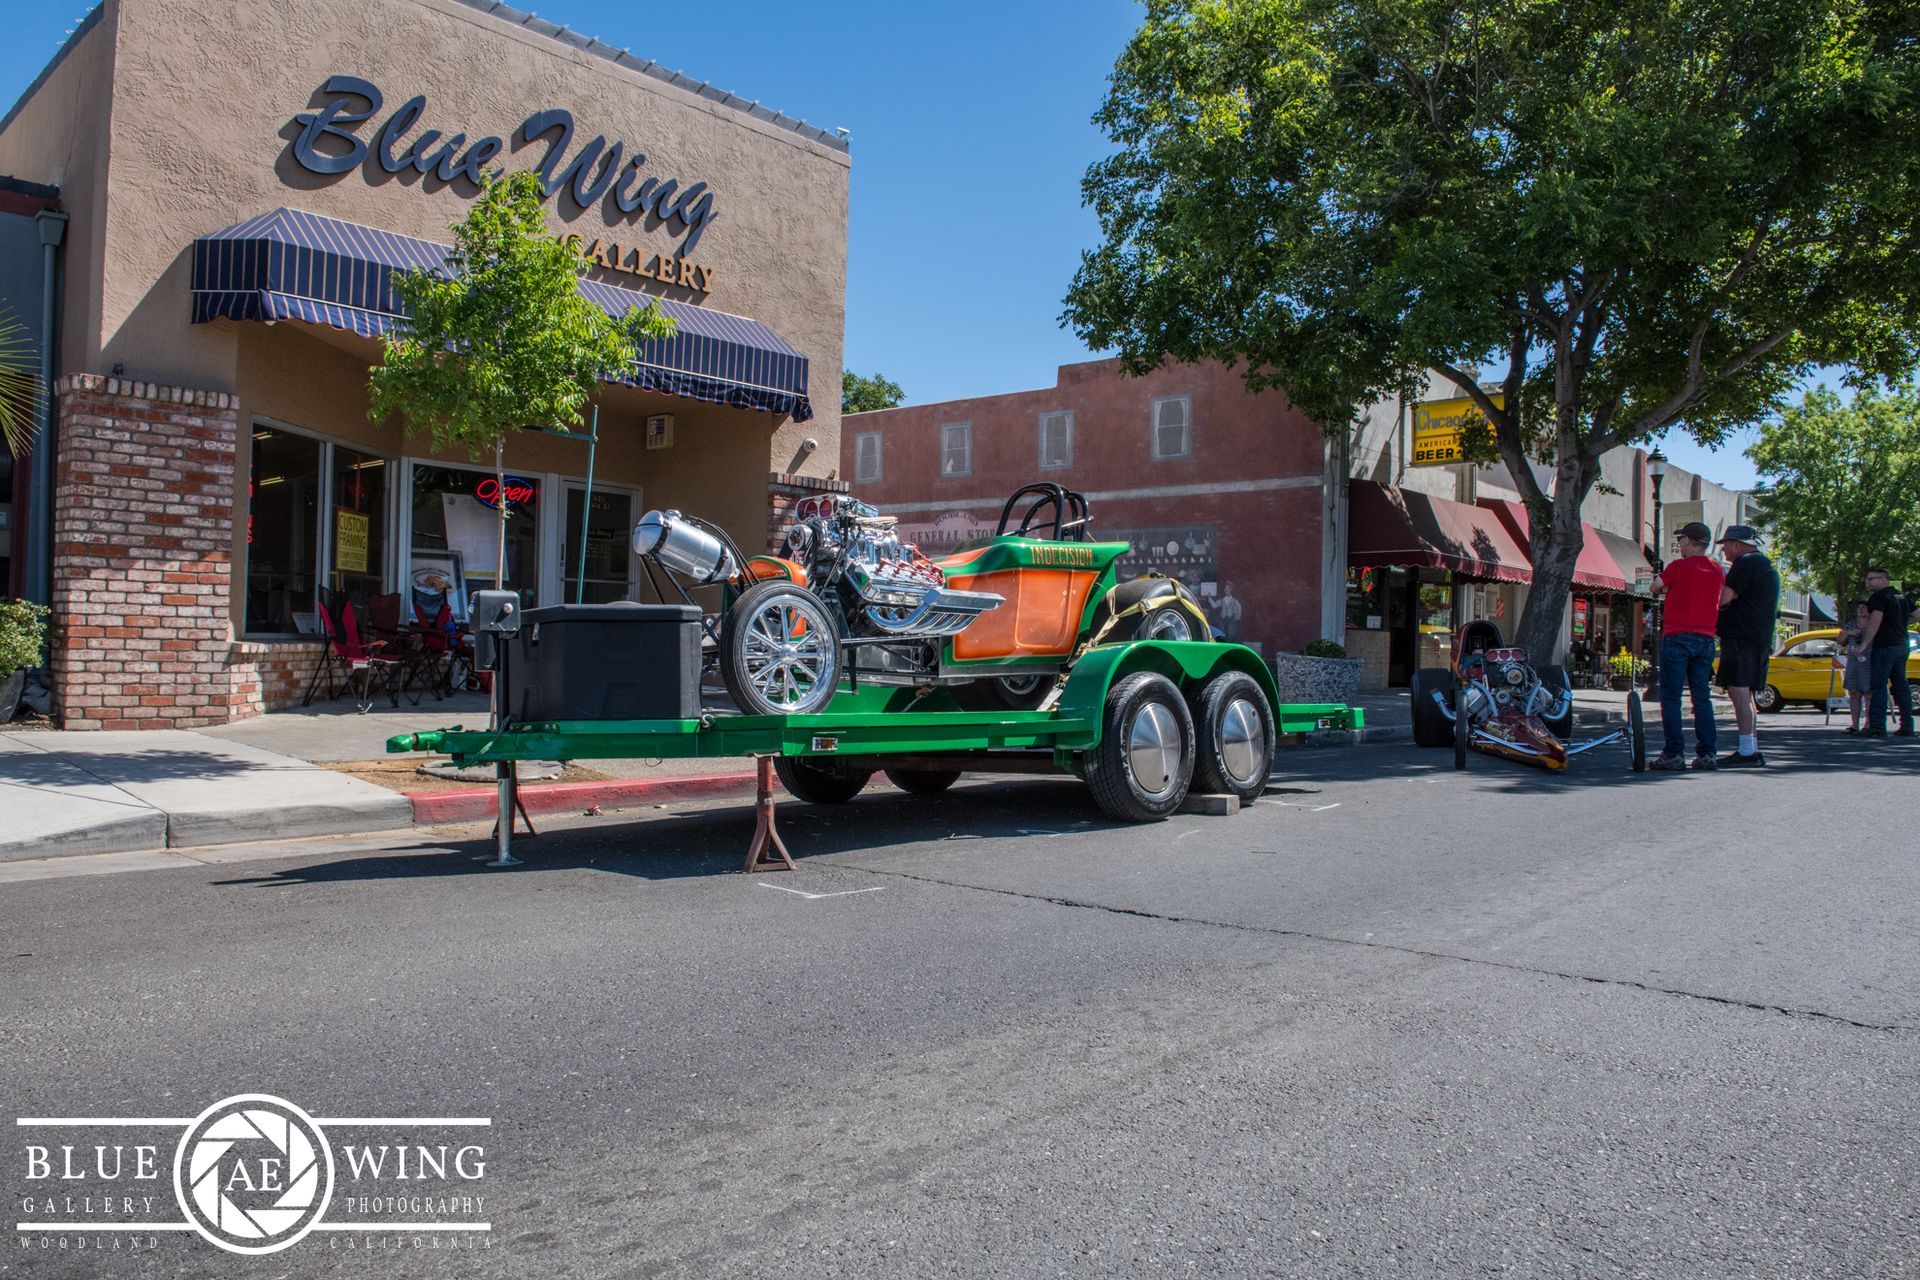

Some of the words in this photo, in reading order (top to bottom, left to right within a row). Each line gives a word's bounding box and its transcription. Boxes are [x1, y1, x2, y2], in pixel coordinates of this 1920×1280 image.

[294, 75, 504, 185] Blue
[524, 108, 719, 256] Wing
[1415, 448, 1454, 461] BEER
[477, 479, 533, 503] Open
[339, 514, 368, 532] CUSTOM
[339, 531, 367, 550] FRAMING
[910, 530, 958, 543] GENERAL
[967, 529, 997, 540] STOR
[1030, 546, 1093, 566] INDECISION
